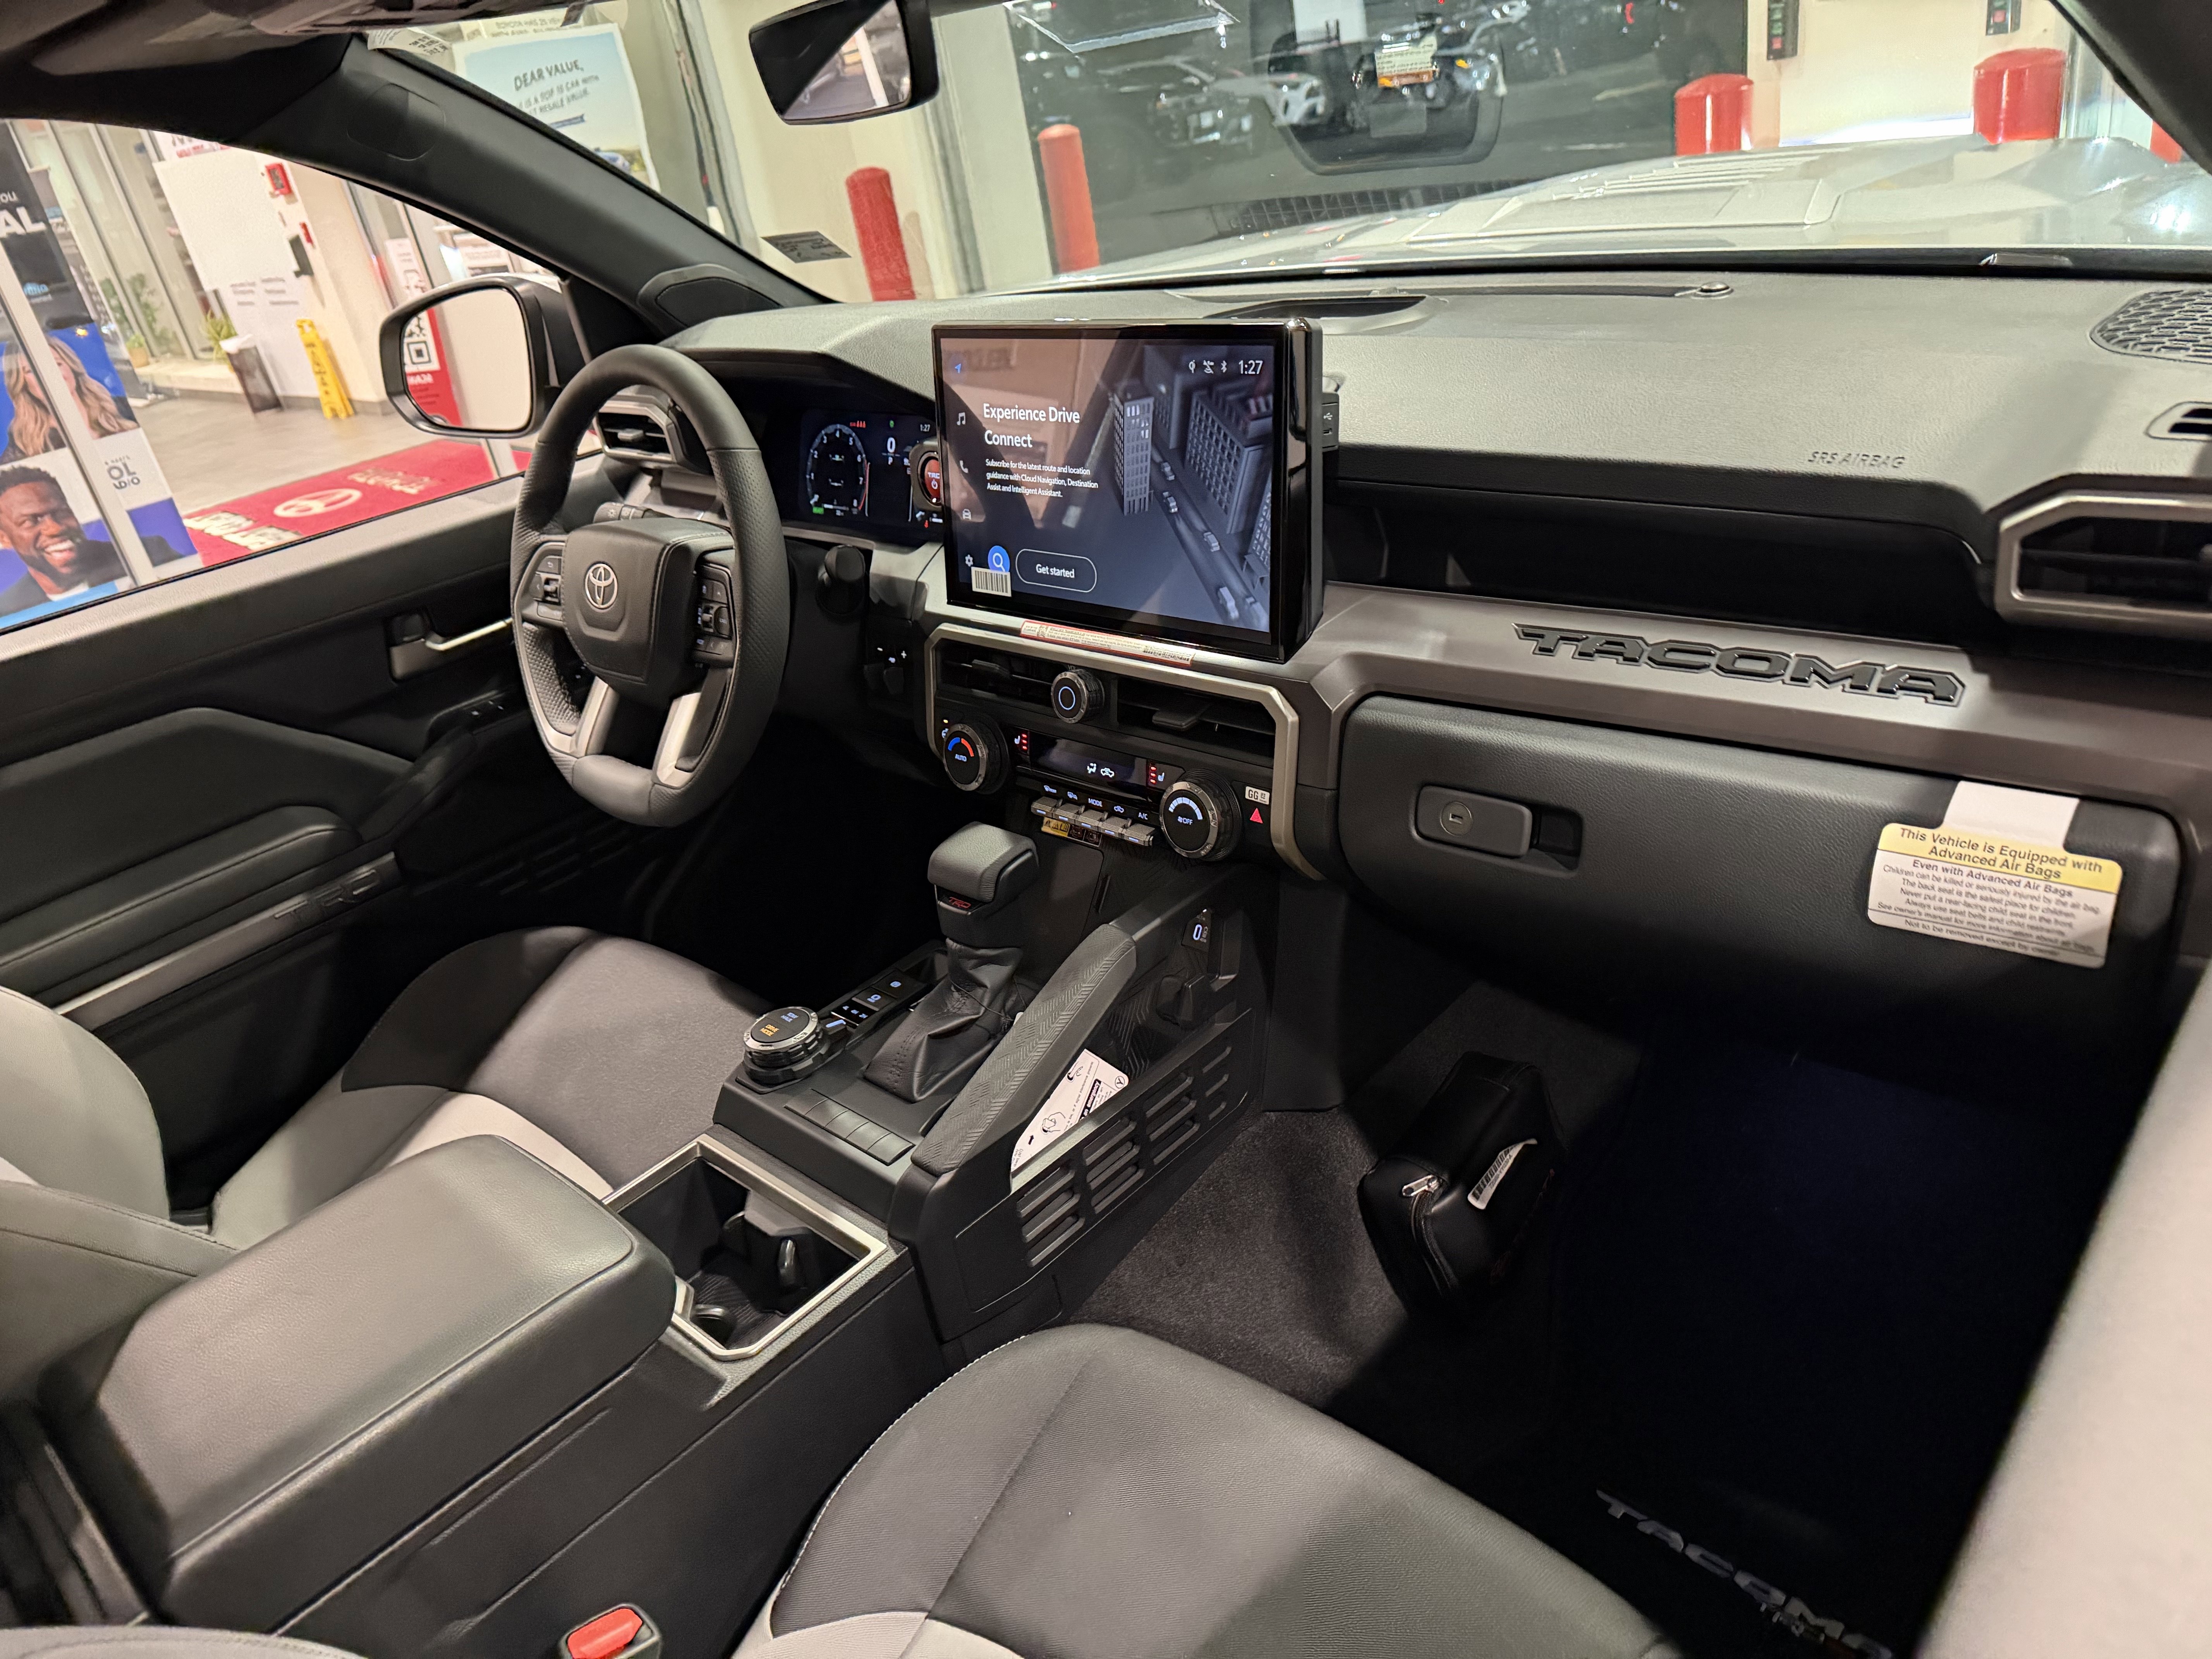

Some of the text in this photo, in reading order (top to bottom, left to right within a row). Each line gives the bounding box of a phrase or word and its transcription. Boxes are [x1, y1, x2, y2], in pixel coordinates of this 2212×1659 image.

[514, 68, 544, 91] DEAR
[1239, 360, 1263, 374] 1:27
[983, 403, 1080, 423] Experience Drive
[887, 437, 896, 453] 0
[984, 430, 1033, 447] Connect
[986, 459, 1010, 468] Subscribe
[1068, 466, 1090, 475] location
[986, 471, 1009, 480] guidance
[1037, 476, 1066, 486] Navigation,
[1067, 479, 1098, 488] Destination
[1012, 486, 1037, 495] Intelligent
[1038, 489, 1063, 497] Assistant.
[1036, 564, 1075, 578] Get started
[1511, 622, 1966, 708] TACOMA
[955, 754, 967, 762] AUTO
[1088, 798, 1103, 807] MODE
[1249, 789, 1258, 800] GG
[1899, 828, 2103, 873] This Vehicle is Equipped with
[1928, 845, 2062, 881] Advanced Air Bags
[1883, 864, 1915, 877] Children
[1915, 872, 1930, 880] can
[1931, 874, 1942, 883] be
[1943, 876, 1964, 887] killed
[1912, 859, 2074, 899] Even with Advanced Air Bags
[1899, 888, 1922, 898] Never
[1923, 893, 1936, 902] put
[1901, 878, 1916, 888] The
[1917, 881, 1936, 891] back
[1937, 886, 1954, 895] seat
[1964, 891, 1978, 899] the
[1877, 901, 1893, 910] See
[1905, 898, 1932, 911] Always
[1904, 919, 1920, 928] Not
[1087, 1081, 1100, 1108] emergency
[1595, 1489, 1893, 1659] TACOMA
